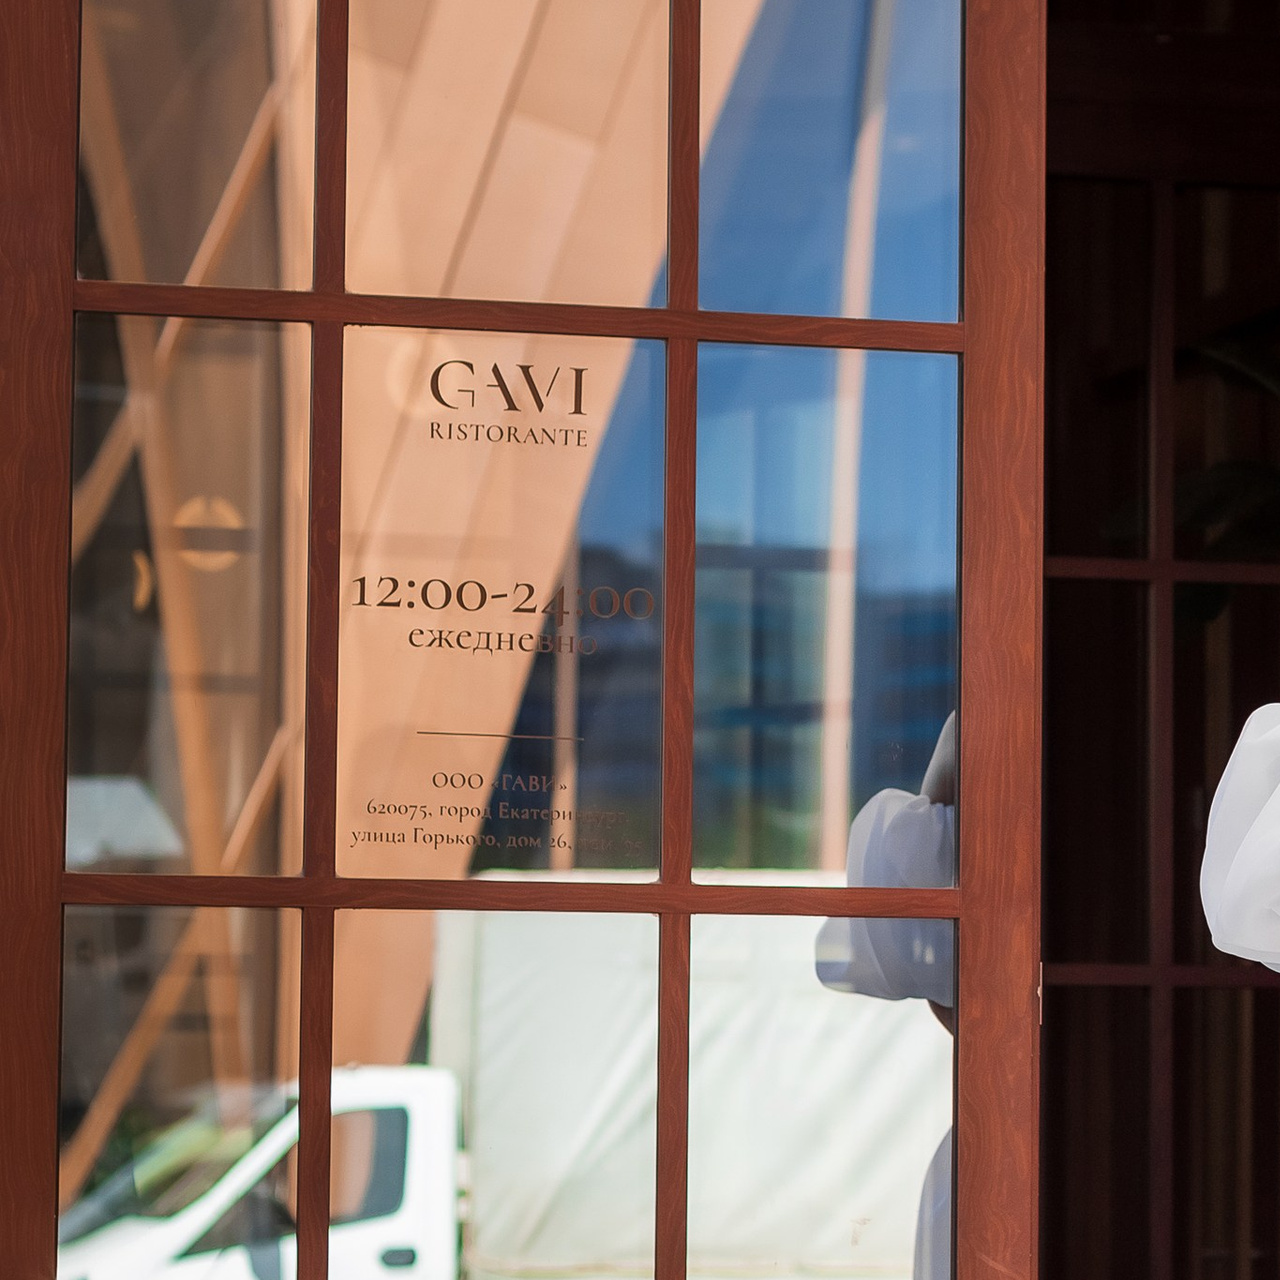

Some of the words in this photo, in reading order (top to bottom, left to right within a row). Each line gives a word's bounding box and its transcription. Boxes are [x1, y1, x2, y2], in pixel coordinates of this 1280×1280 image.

[429, 359, 589, 416] GAVI
[429, 421, 588, 448] RISTORANTE
[351, 575, 655, 628] 12:00-24:00
[407, 627, 598, 656] ежедневно
[432, 771, 484, 790] ООО
[366, 798, 433, 821] 620075,
[439, 804, 492, 823] город
[350, 830, 406, 848] улица
[413, 827, 501, 850] Горького,
[505, 835, 542, 849] дом
[549, 832, 572, 850] 26,
